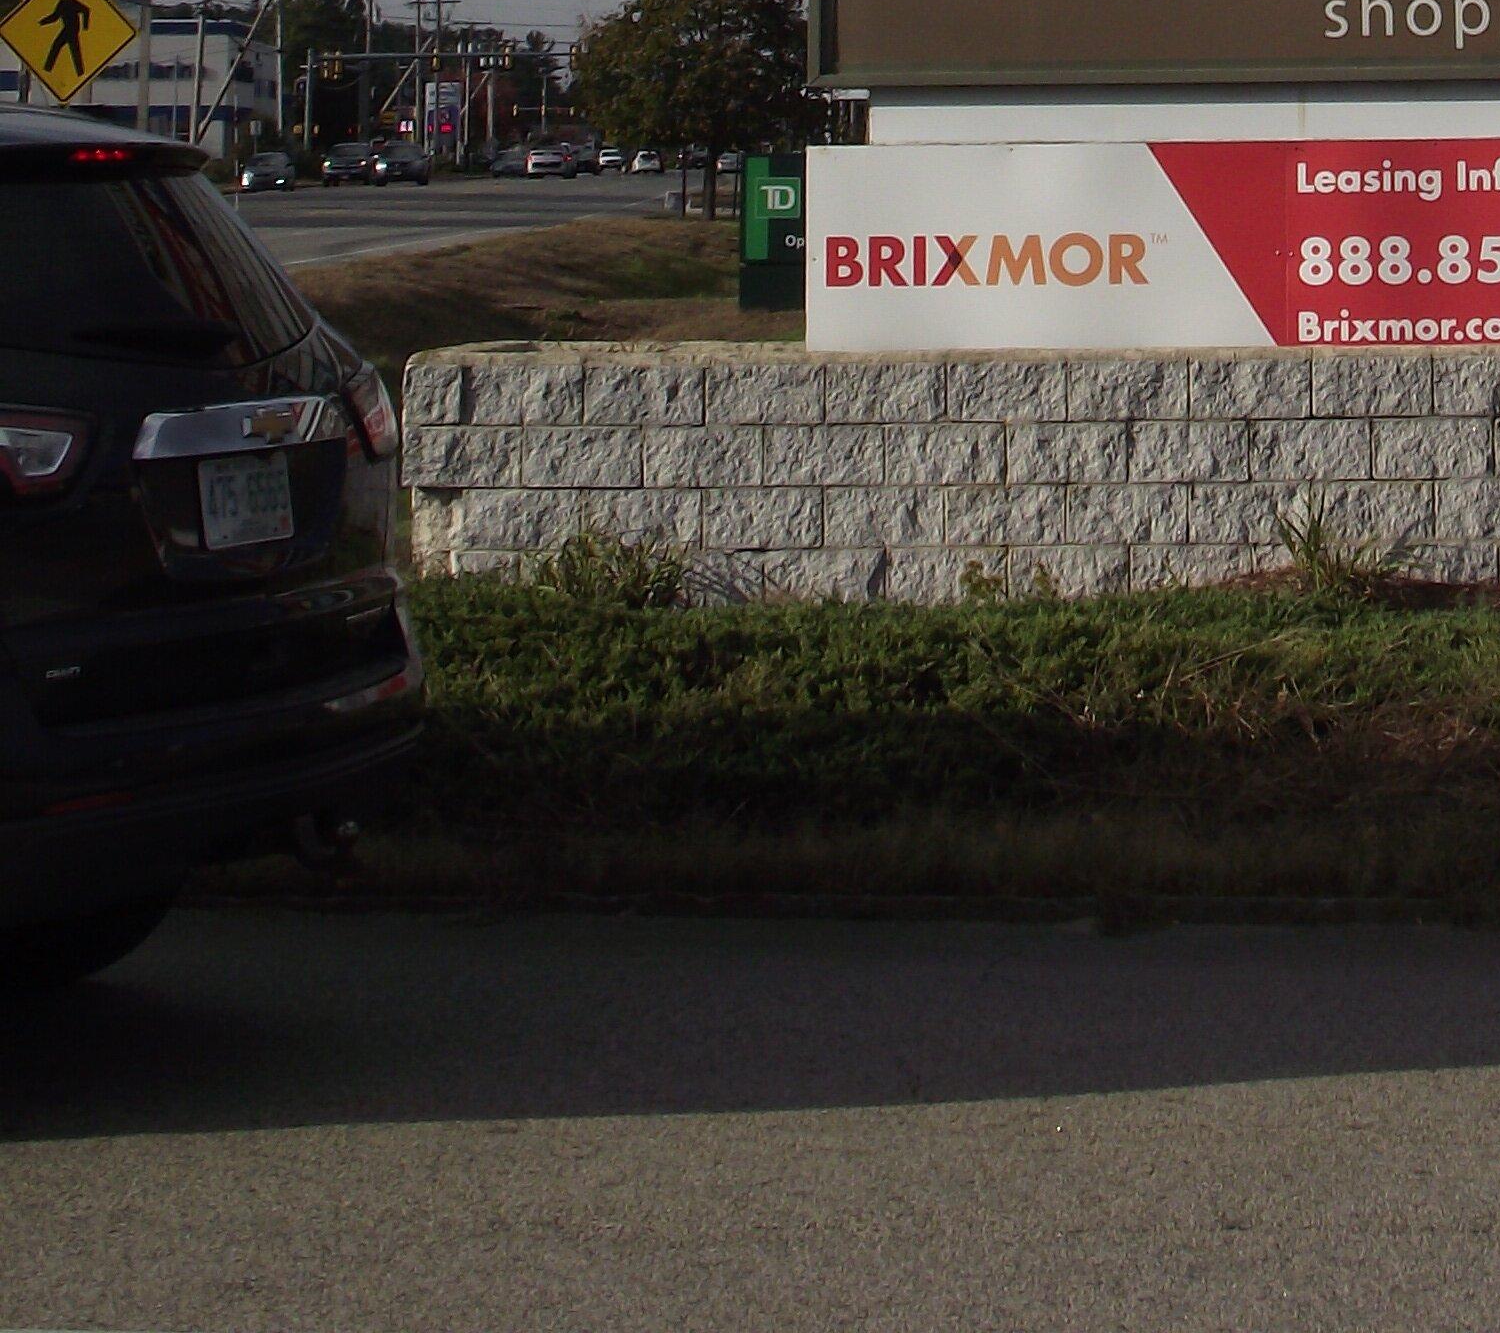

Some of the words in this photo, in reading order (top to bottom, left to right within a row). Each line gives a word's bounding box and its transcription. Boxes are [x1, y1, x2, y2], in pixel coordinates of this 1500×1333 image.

[759, 184, 797, 211] TD
[1298, 160, 1441, 200] Leasing
[826, 233, 1148, 287] BRIXMOR
